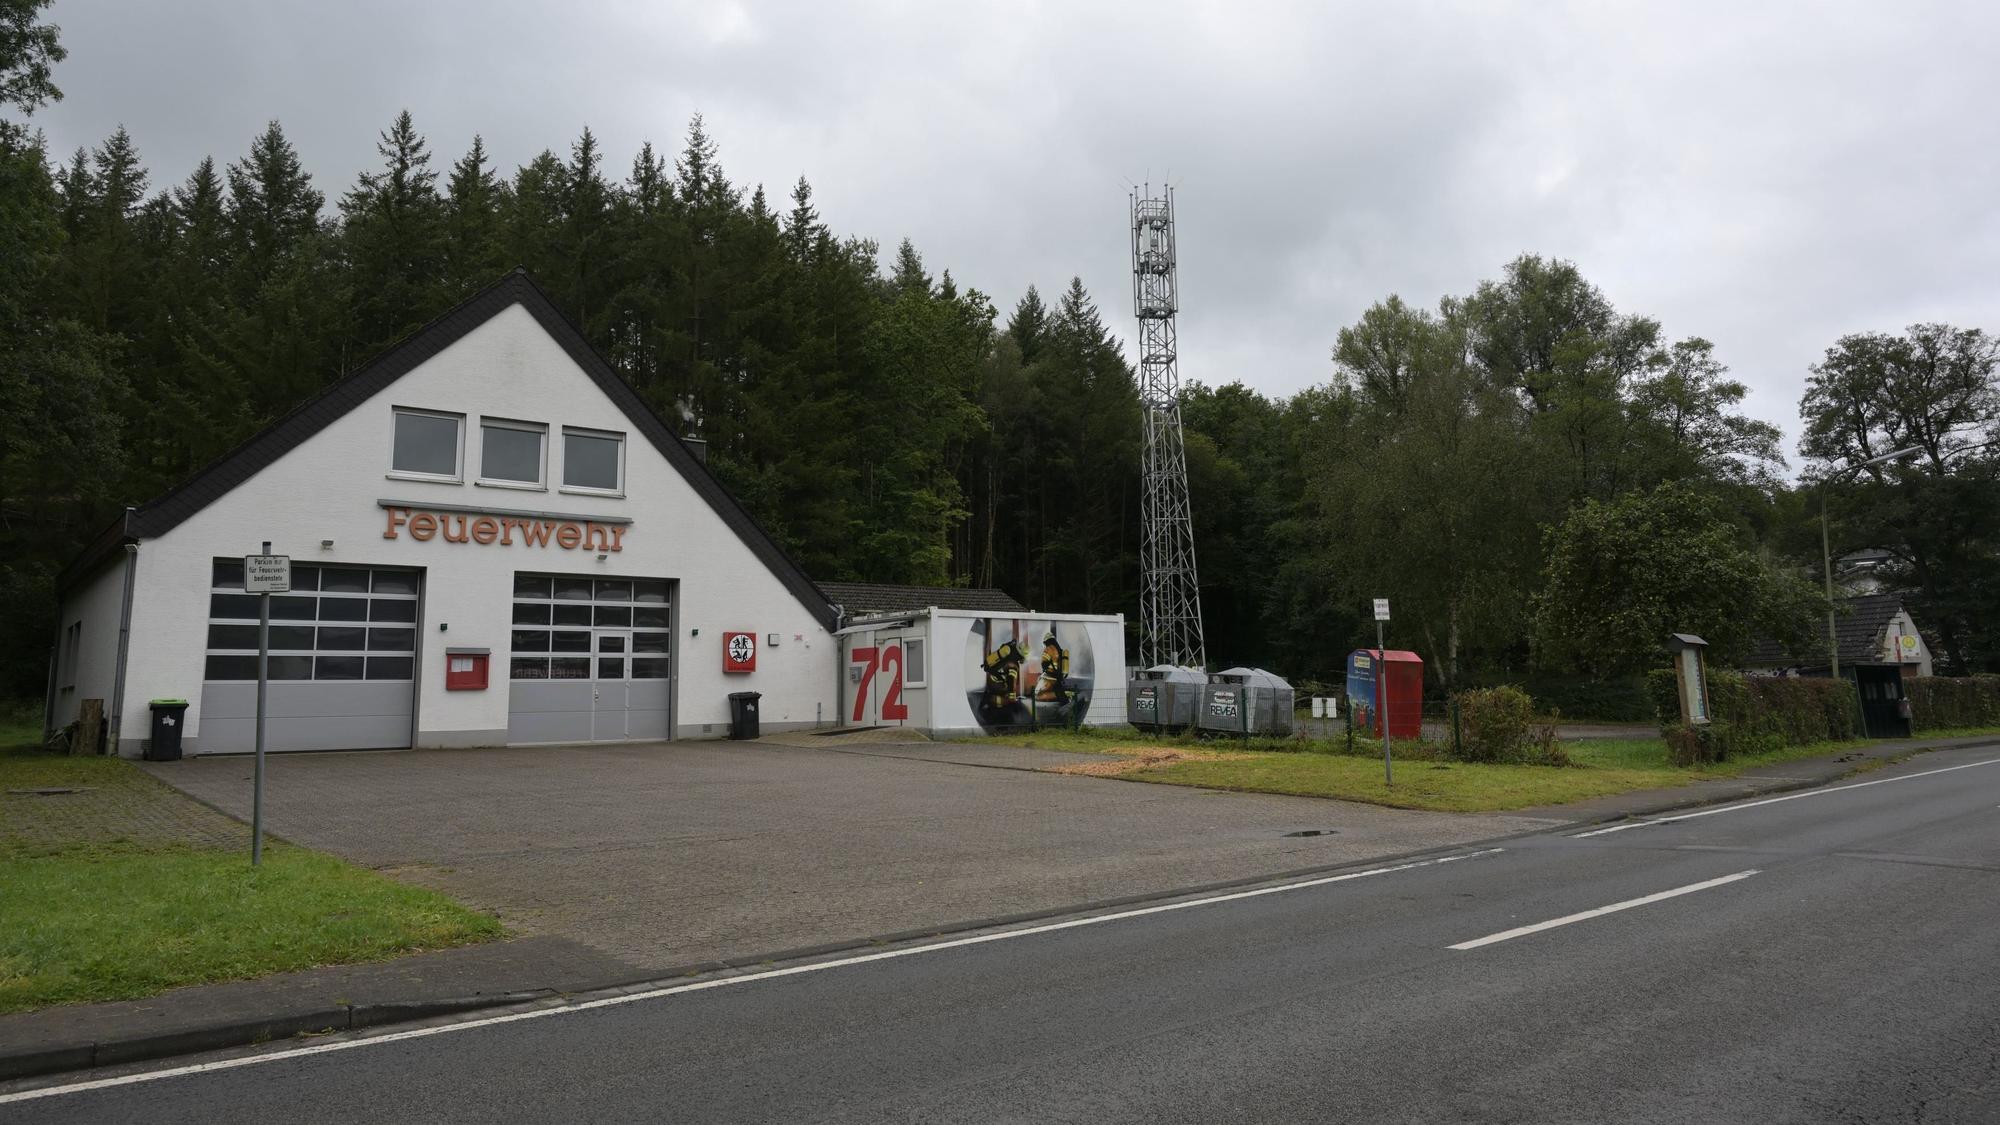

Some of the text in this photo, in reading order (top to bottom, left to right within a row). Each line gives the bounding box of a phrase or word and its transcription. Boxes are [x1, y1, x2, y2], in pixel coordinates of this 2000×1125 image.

[383, 507, 626, 552] Feuerwehr
[852, 646, 908, 721] 72
[1210, 705, 1237, 717] REVEA
